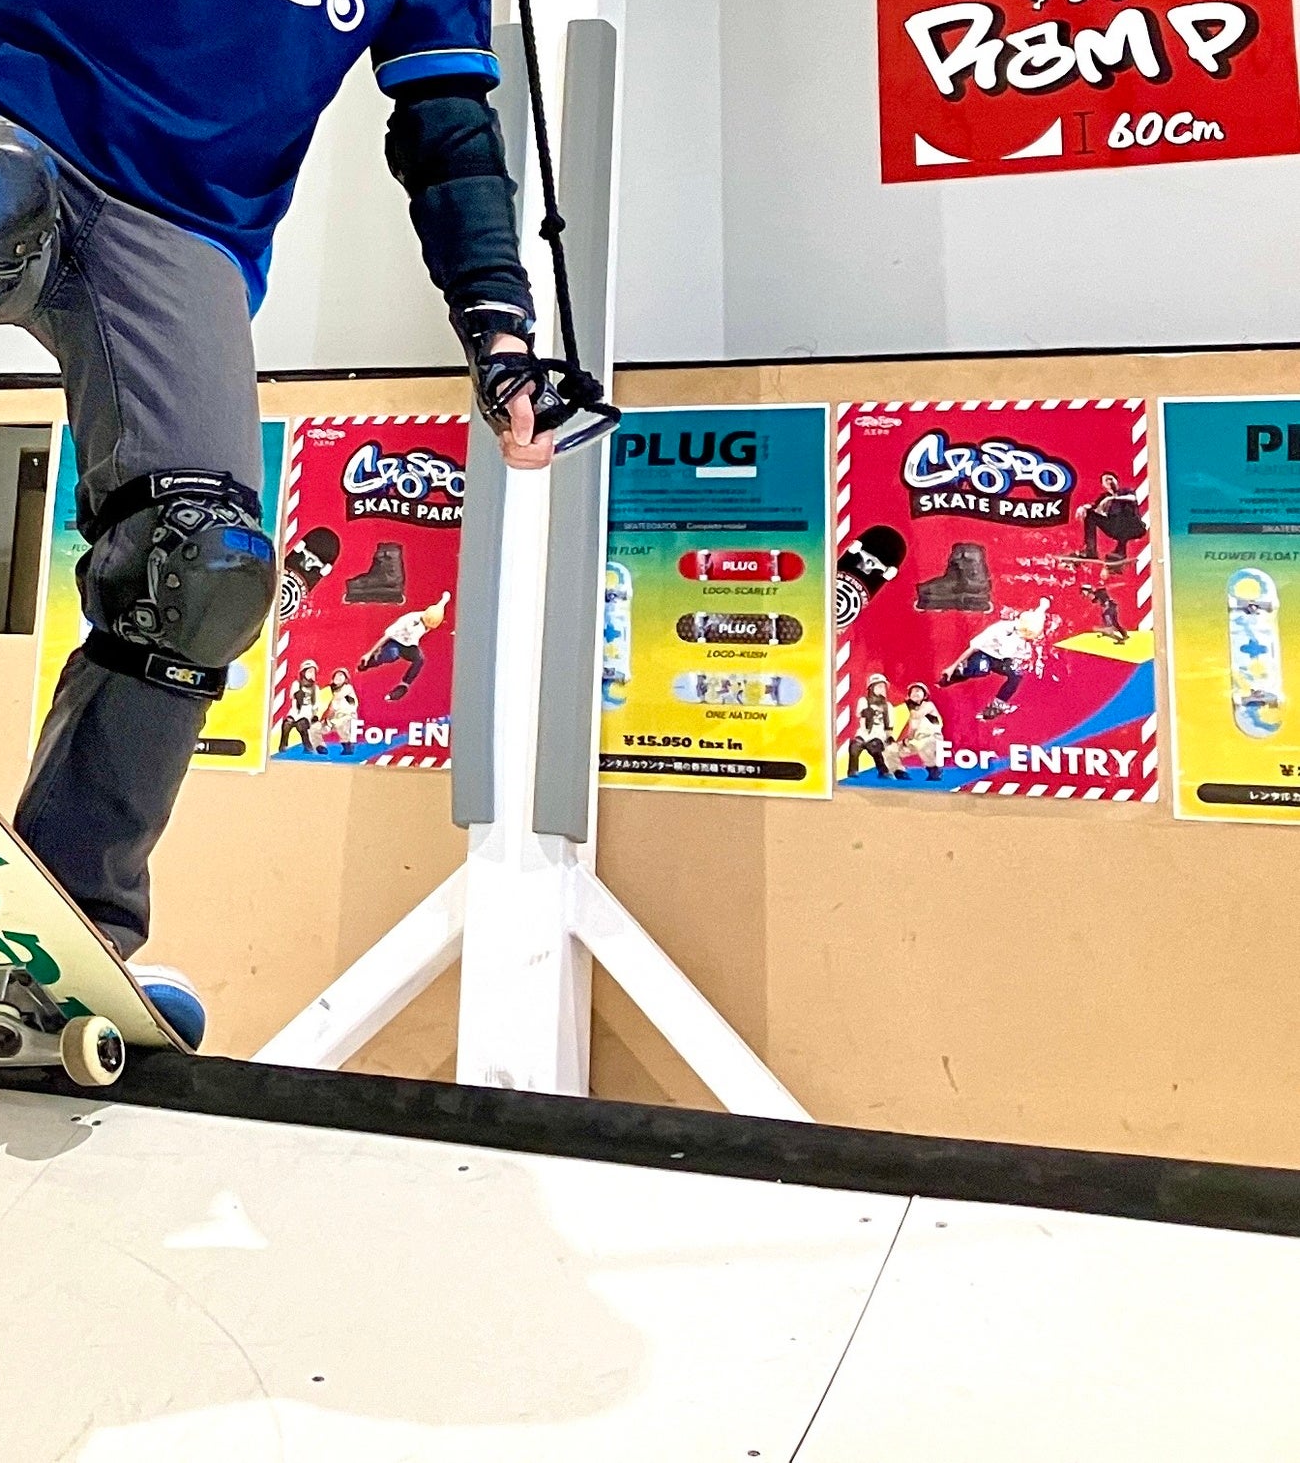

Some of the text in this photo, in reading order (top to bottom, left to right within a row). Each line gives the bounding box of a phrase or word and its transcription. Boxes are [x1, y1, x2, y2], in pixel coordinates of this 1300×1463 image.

[615, 430, 757, 467] PLUG
[354, 498, 464, 521] SKATE PARK
[919, 492, 1063, 519] SKATE PARK
[1259, 551, 1299, 561] FLOAT
[722, 561, 758, 572] PLUG
[718, 623, 758, 635] PLUG
[728, 711, 768, 720] NATION
[350, 718, 398, 745] For
[698, 739, 725, 749] tax
[727, 738, 743, 751] in
[935, 740, 1139, 778] For ENTRY
